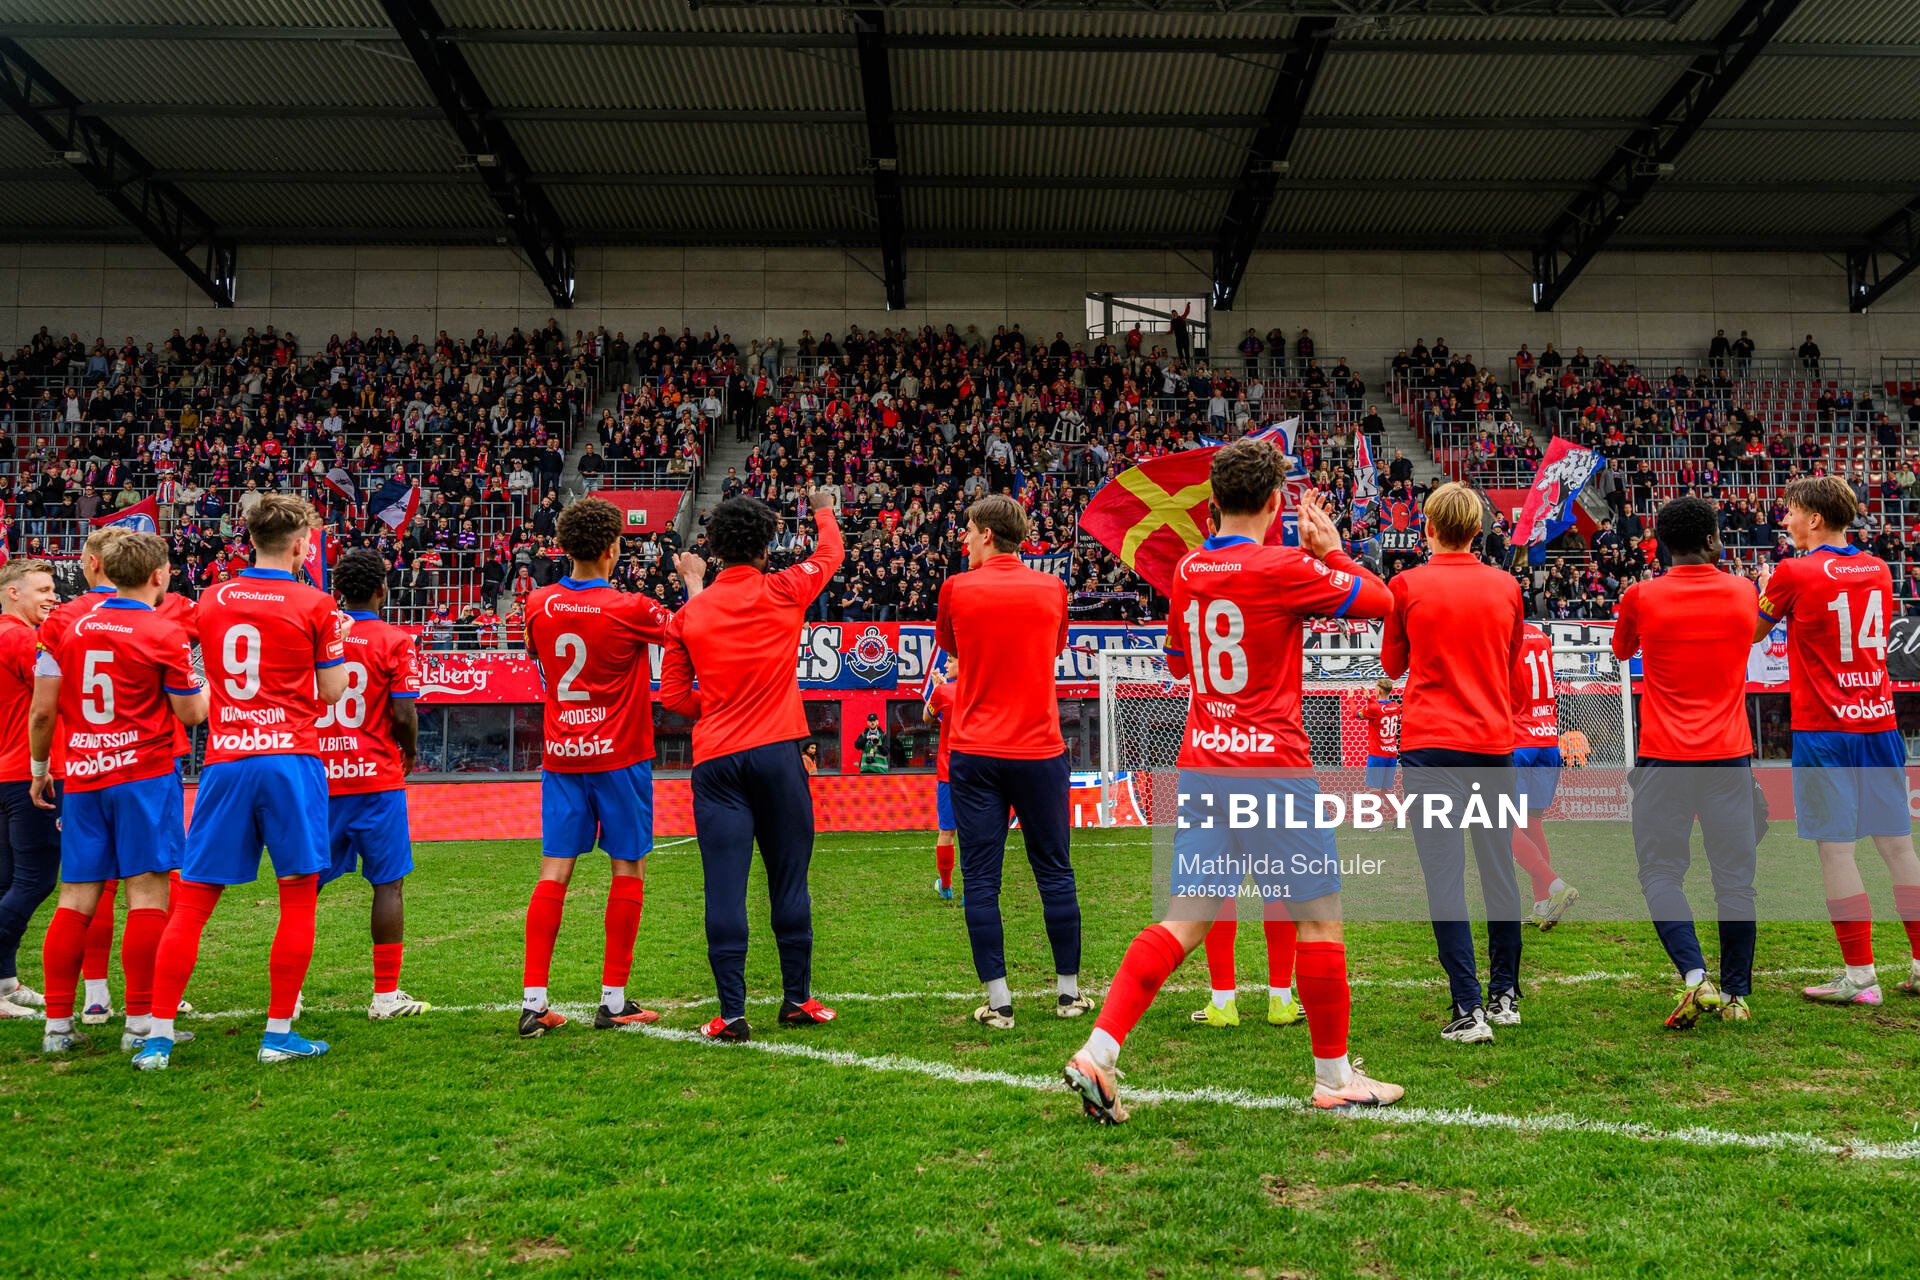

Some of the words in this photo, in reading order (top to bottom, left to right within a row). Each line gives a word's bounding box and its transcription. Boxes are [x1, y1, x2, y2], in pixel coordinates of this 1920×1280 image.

[1382, 532, 1418, 548] HIF
[1188, 562, 1242, 573] NPSolution
[1834, 564, 1881, 574] NPSolution
[228, 591, 285, 602] NPSolution
[553, 603, 601, 614] NPSolution
[84, 622, 133, 634] NPSolution
[1827, 590, 1887, 662] 14
[1183, 599, 1249, 695] 18
[223, 624, 262, 700] 9
[555, 633, 590, 702] 2
[420, 661, 488, 691] lsberg
[1525, 650, 1555, 700] 11
[82, 650, 115, 725] 5
[1832, 696, 1896, 719] vobbiz
[1379, 715, 1398, 737] 36
[212, 728, 294, 751] vobbiz
[546, 734, 614, 757] vobbiz
[1192, 725, 1275, 752] vobbiz
[65, 749, 138, 777] vobbiz
[326, 757, 377, 779] obbiz
